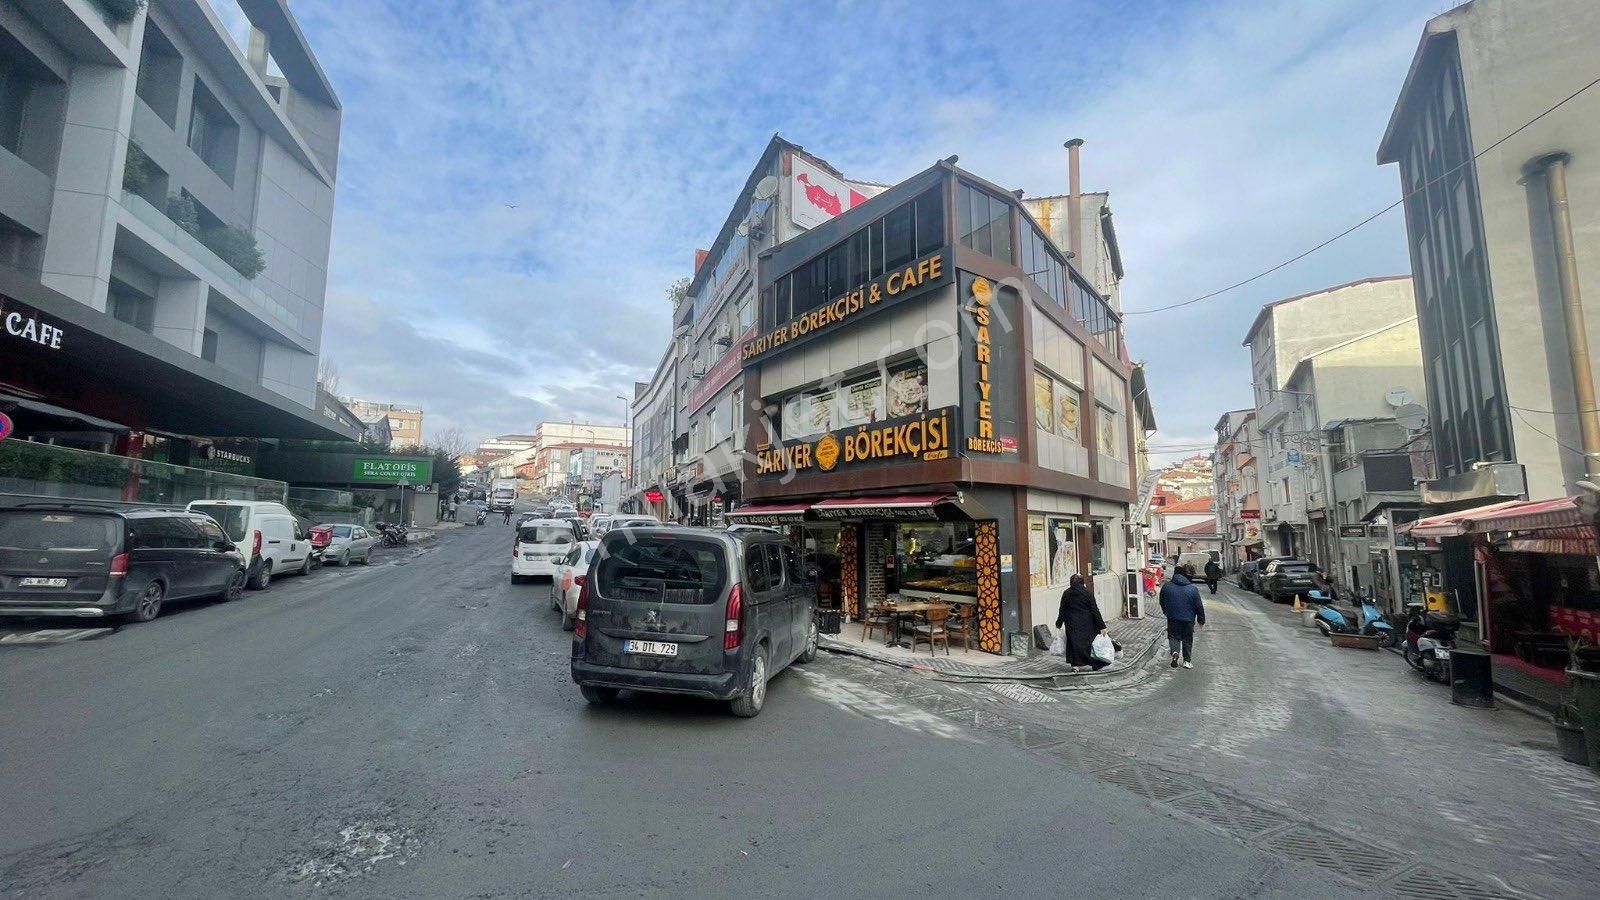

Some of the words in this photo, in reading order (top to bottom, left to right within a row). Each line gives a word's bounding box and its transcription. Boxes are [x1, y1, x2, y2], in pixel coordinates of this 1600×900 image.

[5, 312, 63, 349] CAFE
[742, 326, 788, 360] SARIYER
[791, 284, 864, 338] BÖREKÇİSİ
[868, 282, 882, 304] &
[886, 255, 942, 296] CAFE
[977, 307, 993, 439] SARIYER
[216, 449, 250, 464] STARBUCKS
[756, 443, 812, 474] SARIYER
[844, 409, 948, 462] BÖREKÇİSİ
[630, 641, 639, 651] 34
[642, 642, 655, 652] DTL
[661, 643, 676, 654] 729
